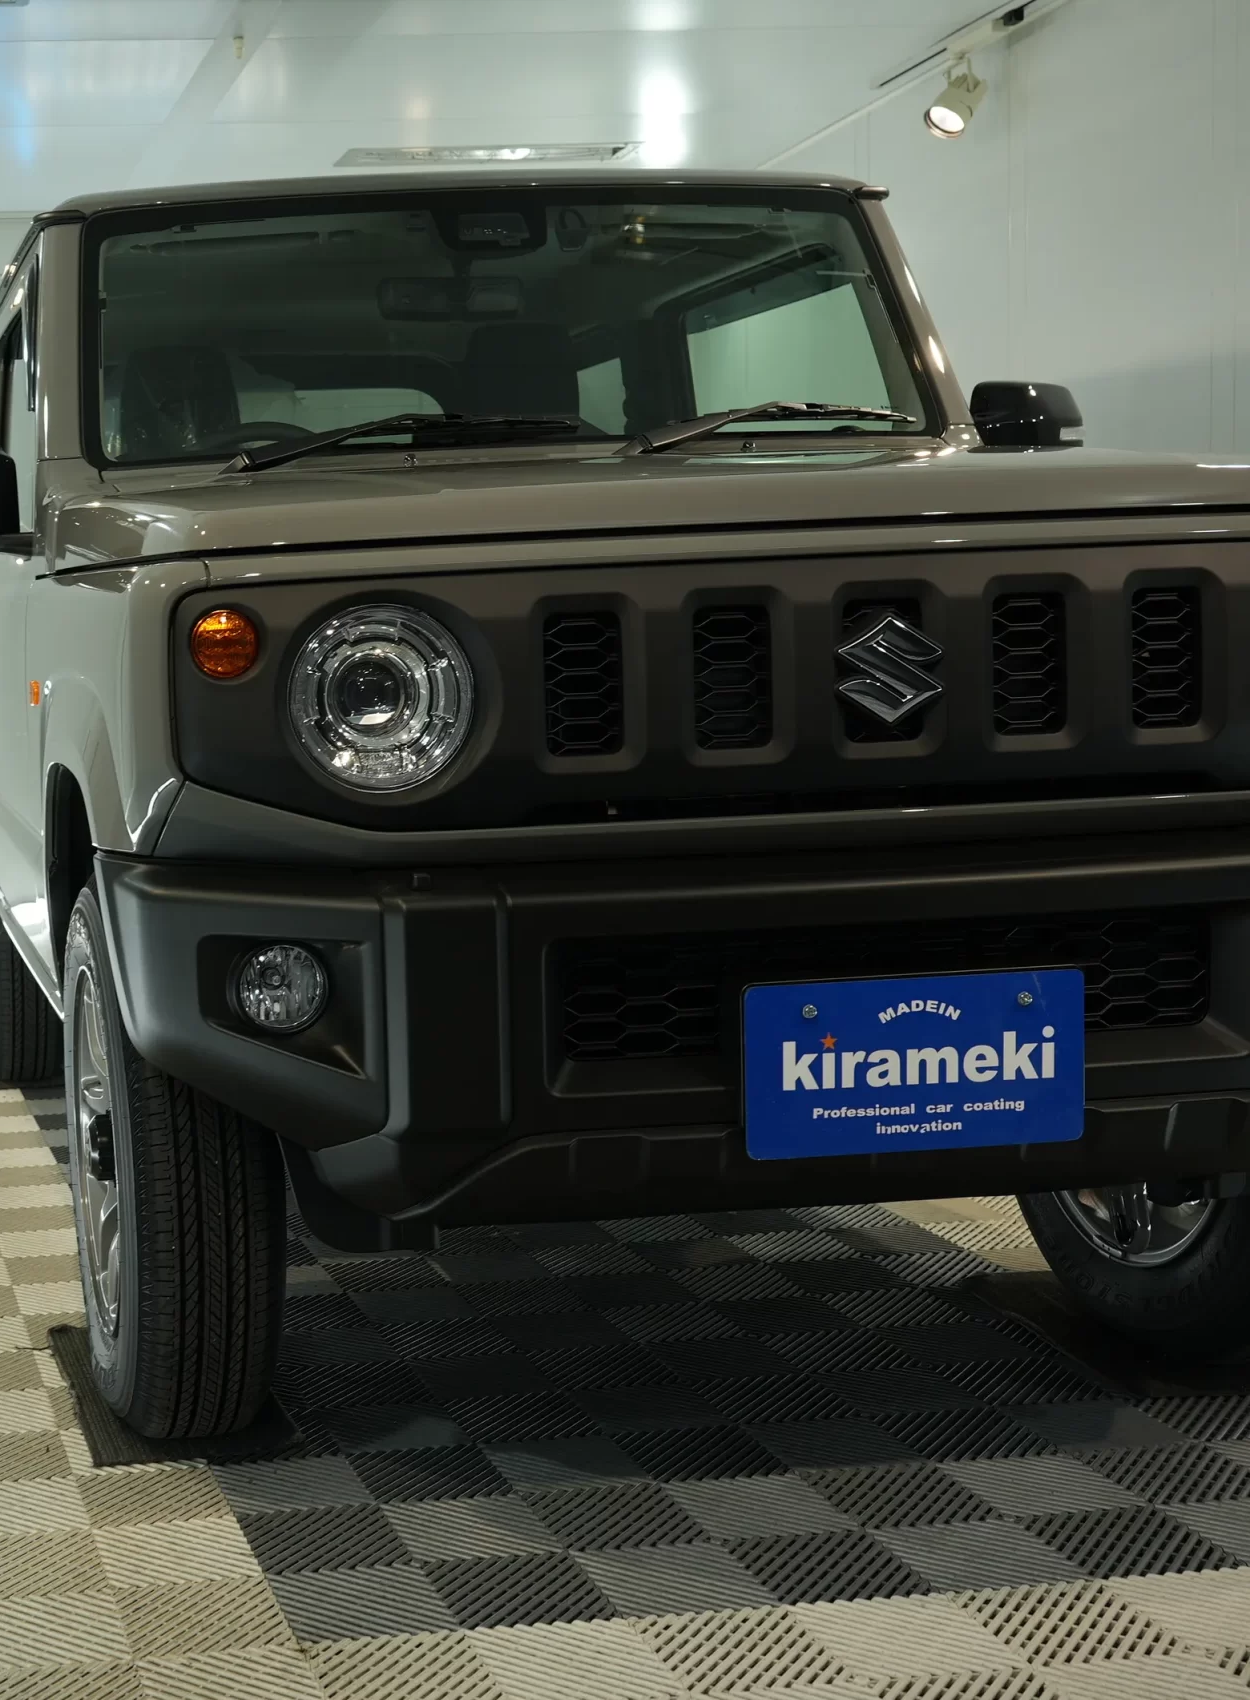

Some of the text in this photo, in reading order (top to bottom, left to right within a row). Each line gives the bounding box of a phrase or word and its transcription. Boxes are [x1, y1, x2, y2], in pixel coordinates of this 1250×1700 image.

[877, 999, 961, 1024] MADEIN
[782, 1025, 1055, 1091] kirameki
[812, 1098, 1025, 1120] Professional car coating
[876, 1119, 963, 1135] innovation
